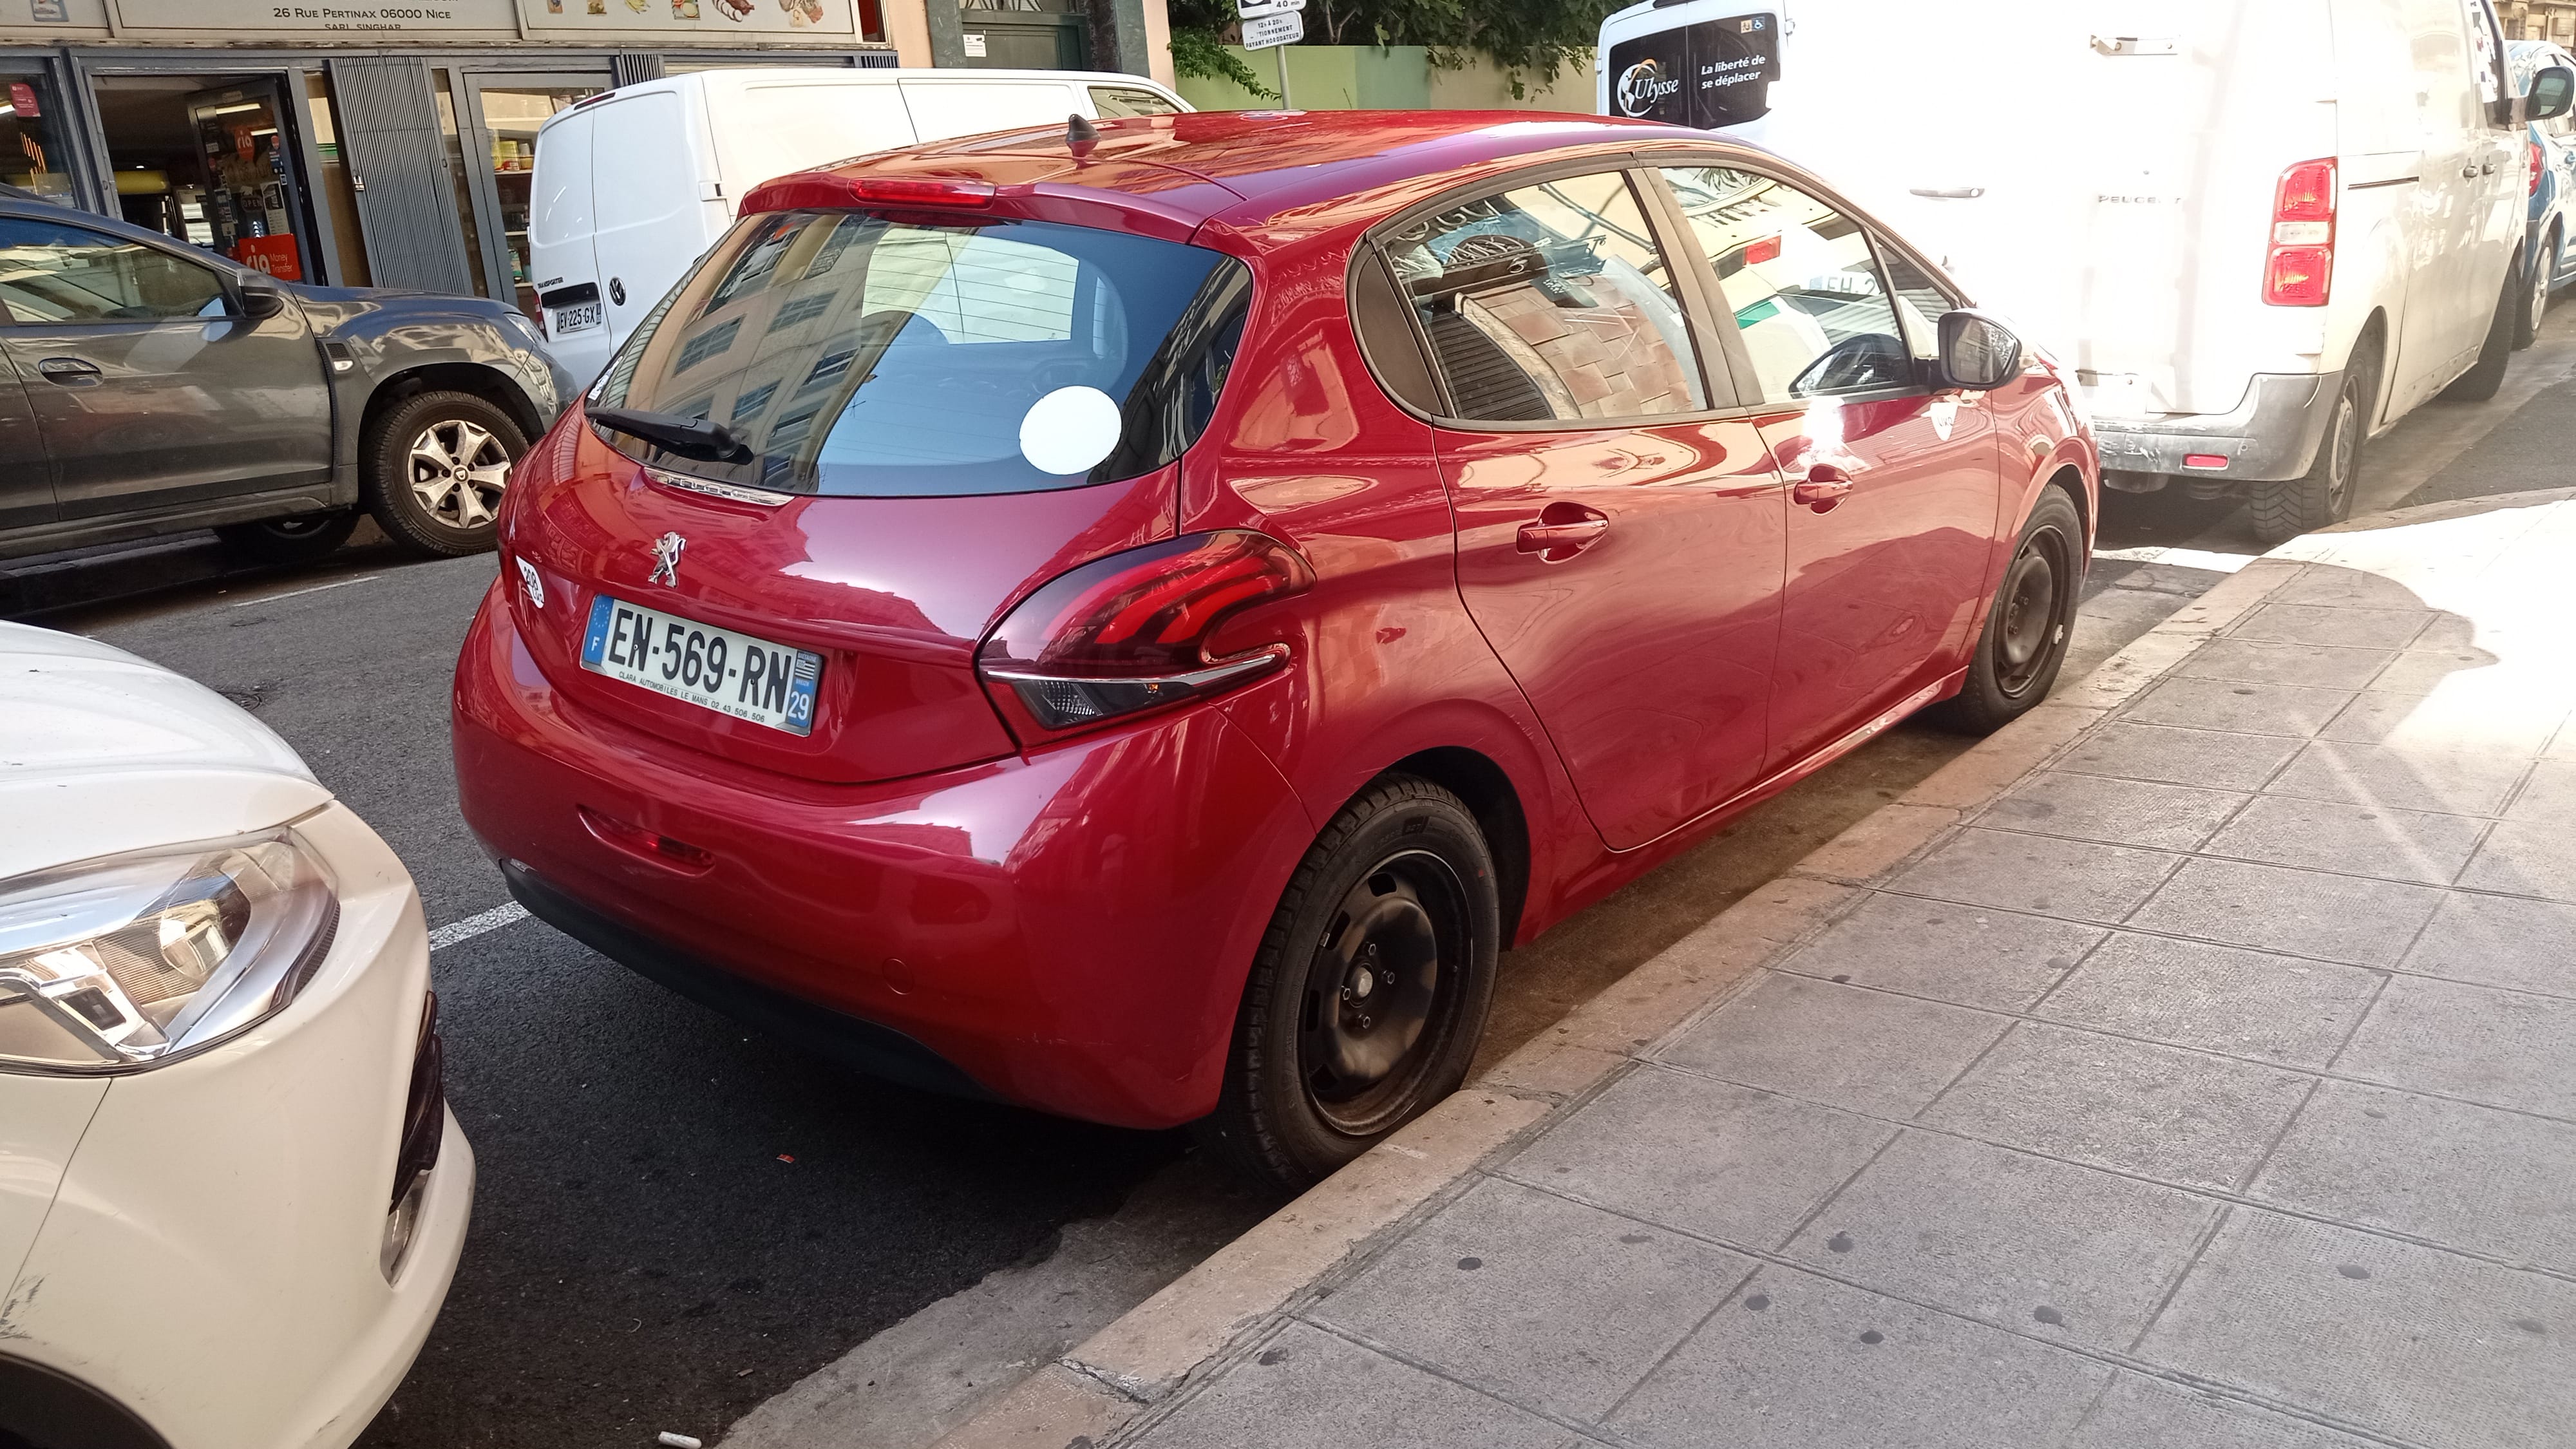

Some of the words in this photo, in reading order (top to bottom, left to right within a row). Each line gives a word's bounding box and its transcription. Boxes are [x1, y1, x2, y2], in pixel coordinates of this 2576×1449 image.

[273, 8, 290, 17] 26
[323, 8, 377, 19] PERTINAX
[381, 9, 422, 19] 06000
[426, 10, 451, 19] NICE
[1245, 39, 1264, 48] PAYANT
[1265, 32, 1299, 44] HORODATEUR
[1701, 65, 1713, 75] La
[1715, 57, 1749, 73] liberté
[1751, 55, 1766, 65] de
[1634, 77, 1679, 103] Ulysse
[1701, 80, 1713, 90] se
[1715, 71, 1761, 87] déplacer
[237, 131, 252, 149] ria
[2098, 195, 2181, 204] PEUGET
[246, 244, 271, 274] ria
[270, 253, 288, 262] Money
[272, 263, 293, 273] Transfer
[591, 636, 600, 651] F
[608, 608, 791, 714] EN-569-RN
[619, 671, 636, 683] CLARA
[639, 679, 678, 696] AUTOMOBILES
[692, 695, 708, 706] MANS
[788, 691, 810, 720] 29
